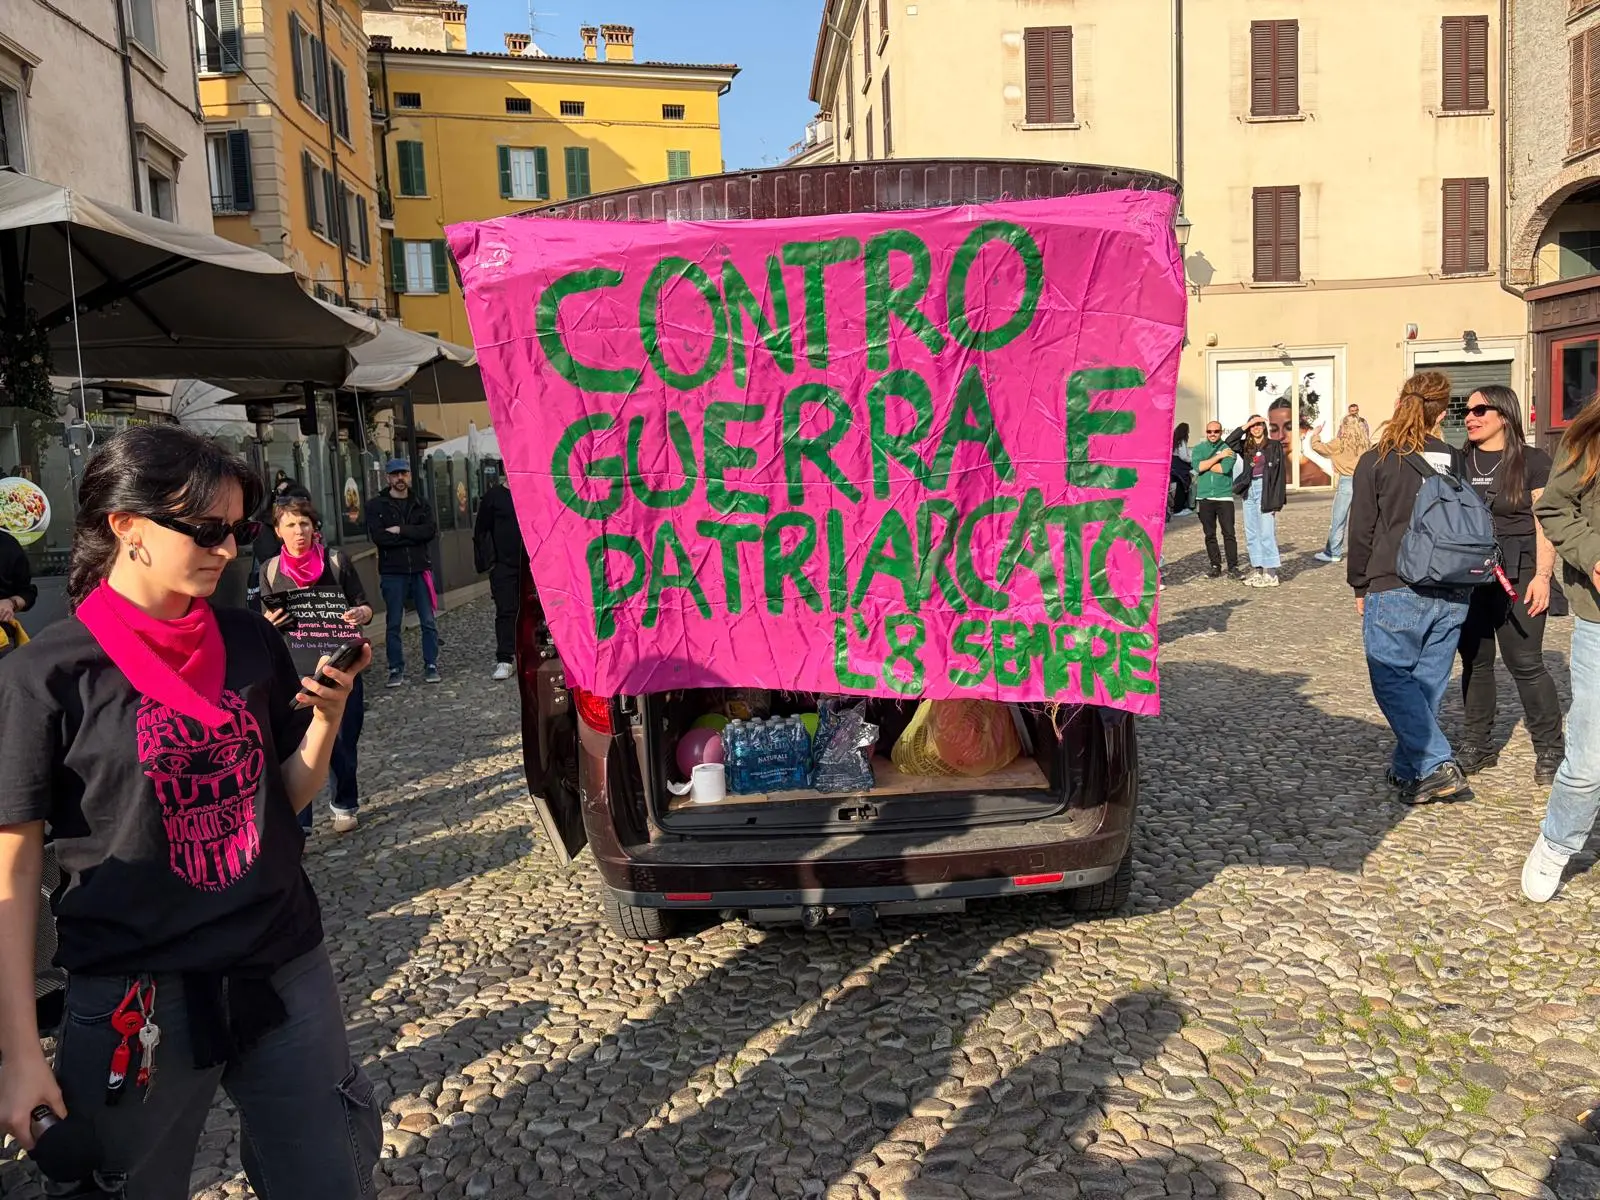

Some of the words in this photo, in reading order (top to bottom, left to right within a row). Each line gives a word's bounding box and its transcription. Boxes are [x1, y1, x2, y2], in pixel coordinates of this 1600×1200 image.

[535, 219, 1046, 393] CONTRO
[551, 365, 1015, 520] GUERRA
[1065, 366, 1147, 490] E
[585, 488, 1160, 641] PATRIARCATO
[951, 620, 1157, 700] SEMPRE
[144, 748, 264, 806] TUTTO
[169, 820, 260, 886] L'ULTIMA
